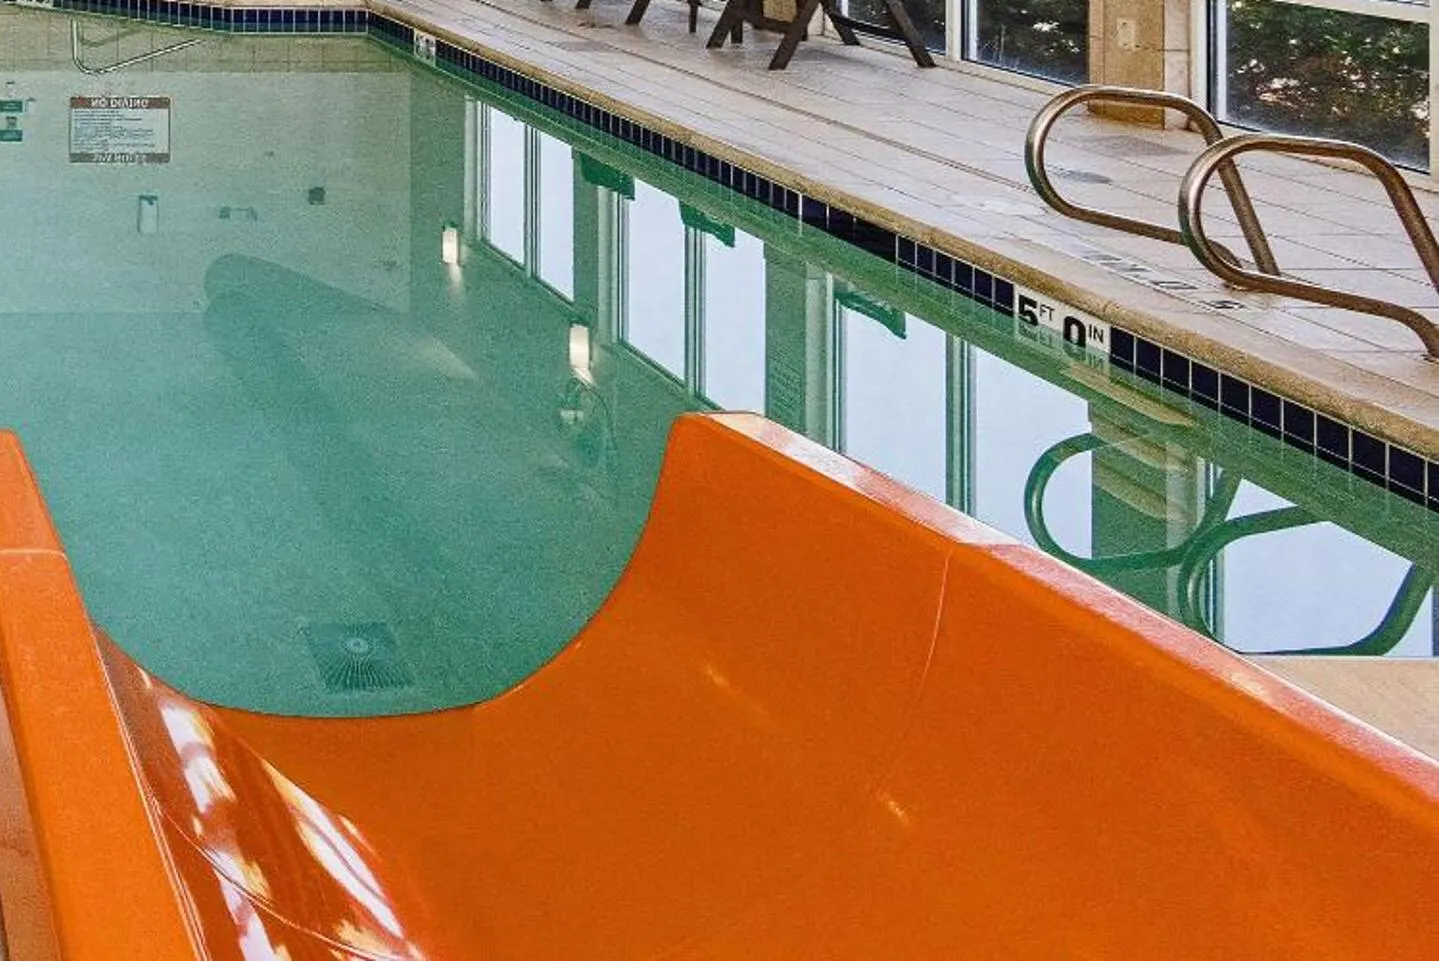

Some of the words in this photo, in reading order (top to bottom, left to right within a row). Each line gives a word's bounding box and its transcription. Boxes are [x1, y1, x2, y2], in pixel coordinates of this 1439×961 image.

[1018, 294, 1039, 328] 5
[1039, 303, 1055, 321] FT
[1063, 315, 1087, 349] 0
[1088, 323, 1104, 344] IN
